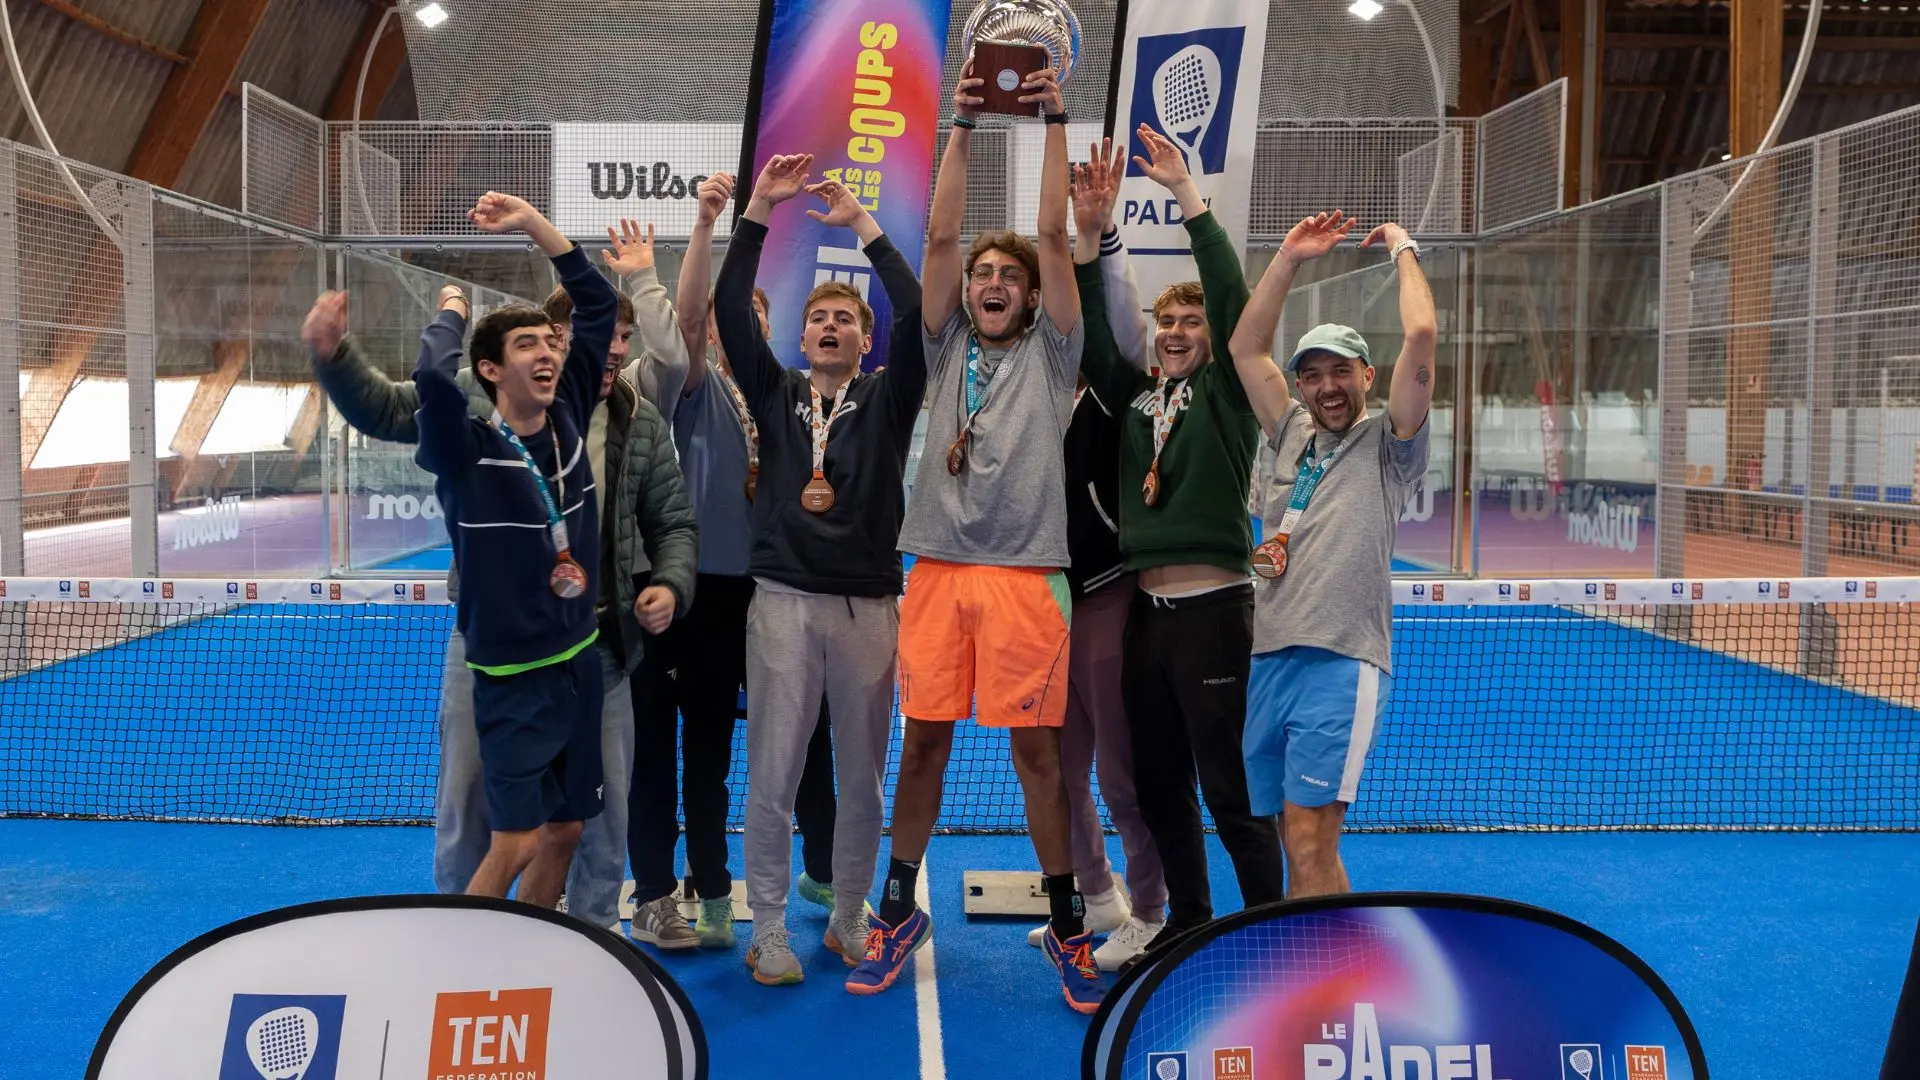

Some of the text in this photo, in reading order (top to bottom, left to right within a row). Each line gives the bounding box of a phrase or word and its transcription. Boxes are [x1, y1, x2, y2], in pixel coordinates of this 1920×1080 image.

[847, 21, 906, 163] COUPS
[587, 161, 737, 200] Wils
[861, 170, 882, 211] LES
[1203, 676, 1236, 685] HEAD
[1301, 774, 1328, 787] HEAD
[448, 1014, 529, 1066] TEN
[1303, 1002, 1512, 1080] PADEL
[1321, 1023, 1347, 1040] LE
[1219, 1055, 1246, 1074] TEN
[1631, 1054, 1659, 1072] TEN
